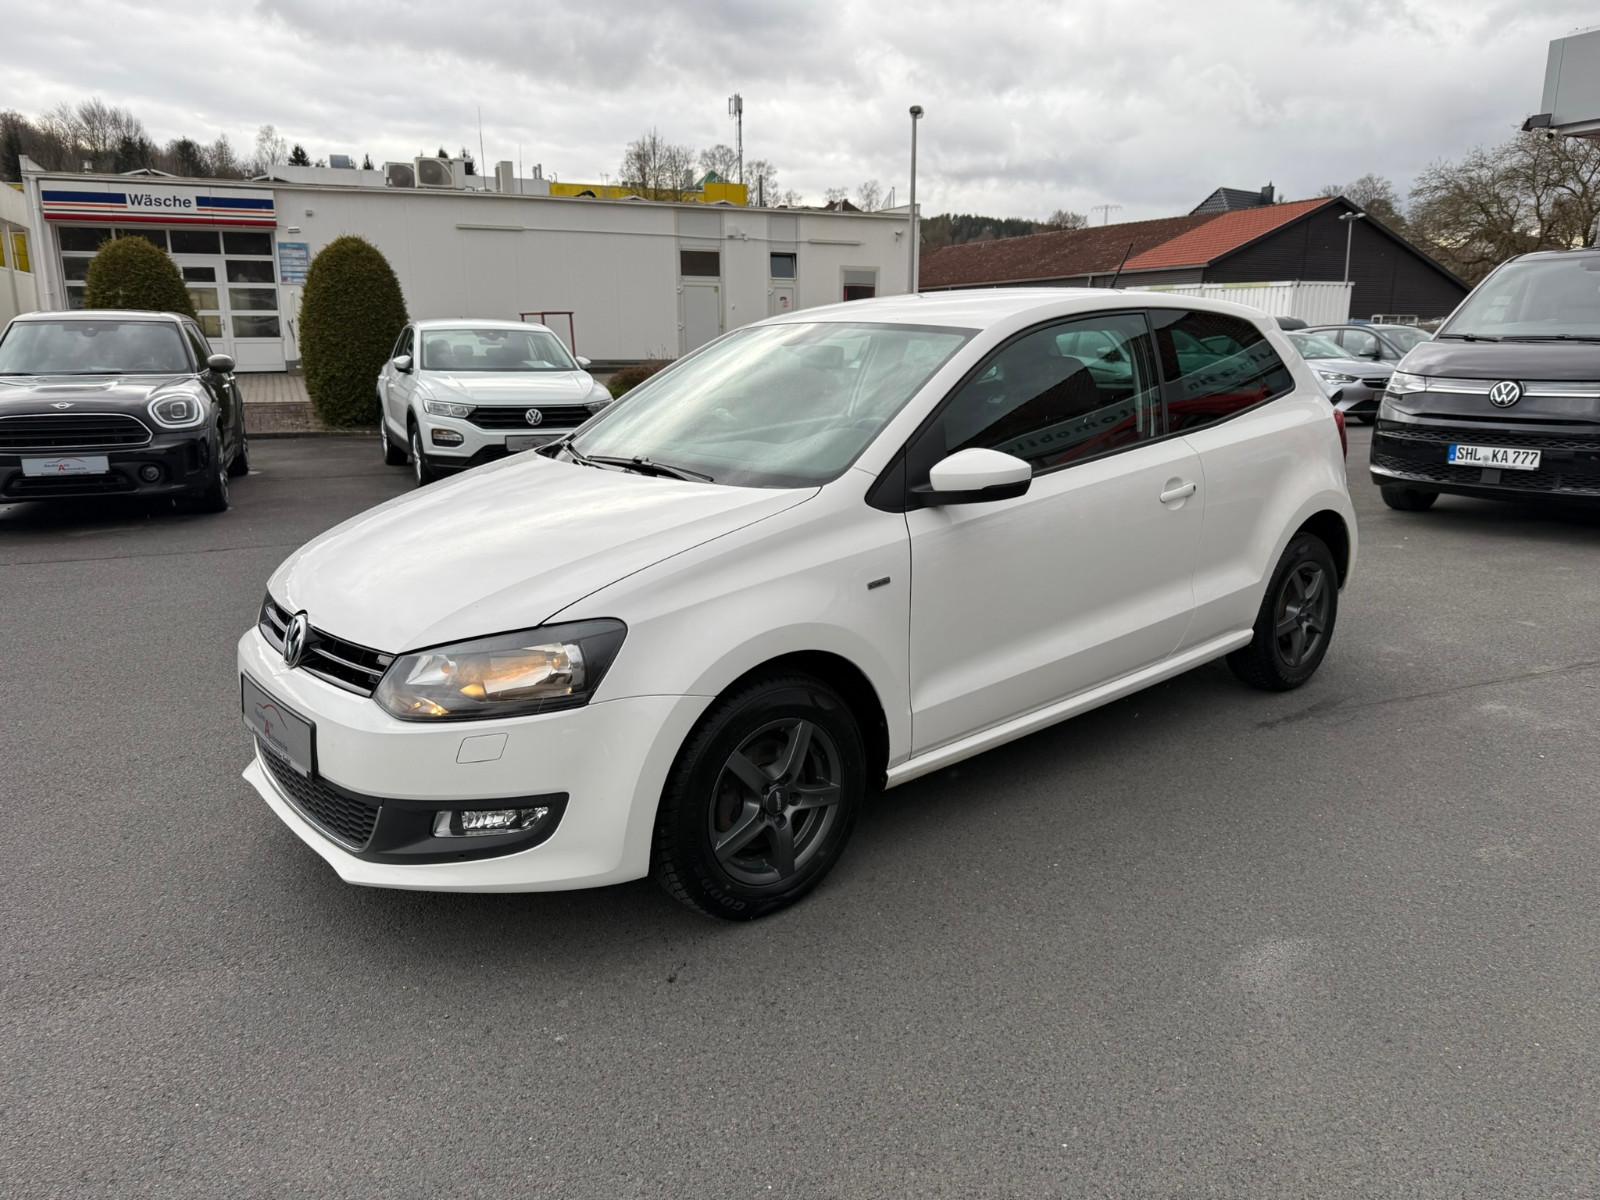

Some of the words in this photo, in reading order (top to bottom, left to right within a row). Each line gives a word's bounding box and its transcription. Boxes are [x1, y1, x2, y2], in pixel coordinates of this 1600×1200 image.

[128, 193, 192, 208] Wäsche
[1456, 446, 1481, 461] SHL
[1491, 449, 1509, 464] KA
[1512, 450, 1539, 465] 777
